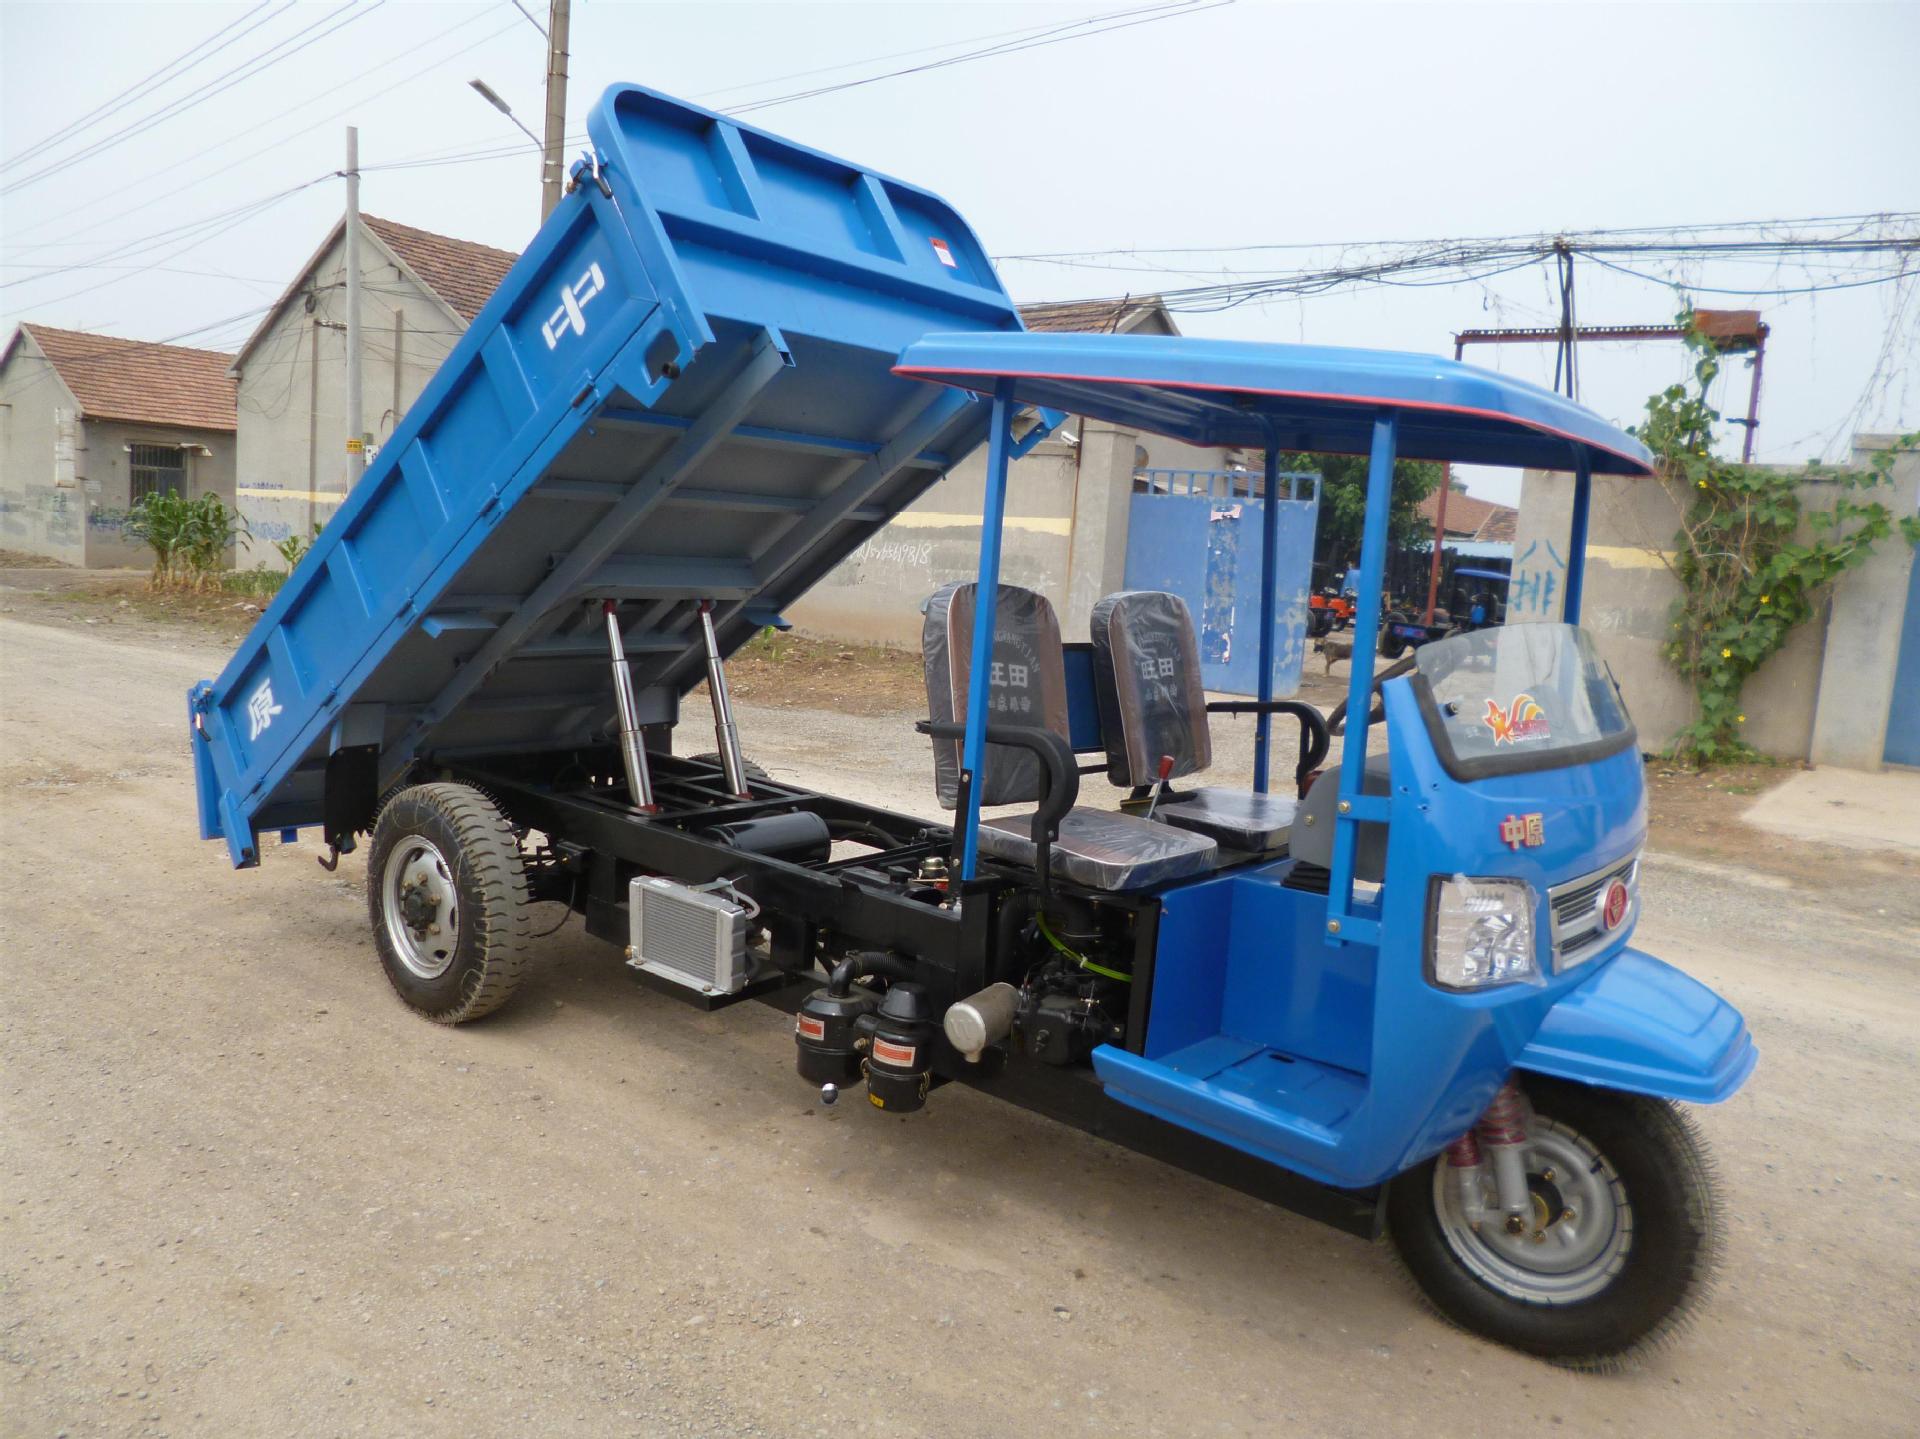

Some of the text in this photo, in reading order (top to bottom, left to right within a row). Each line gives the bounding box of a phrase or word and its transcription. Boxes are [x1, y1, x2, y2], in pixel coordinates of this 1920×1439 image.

[542, 262, 605, 350] 中
[1141, 658, 1175, 680] 旺田
[1499, 812, 1545, 851] 中原
